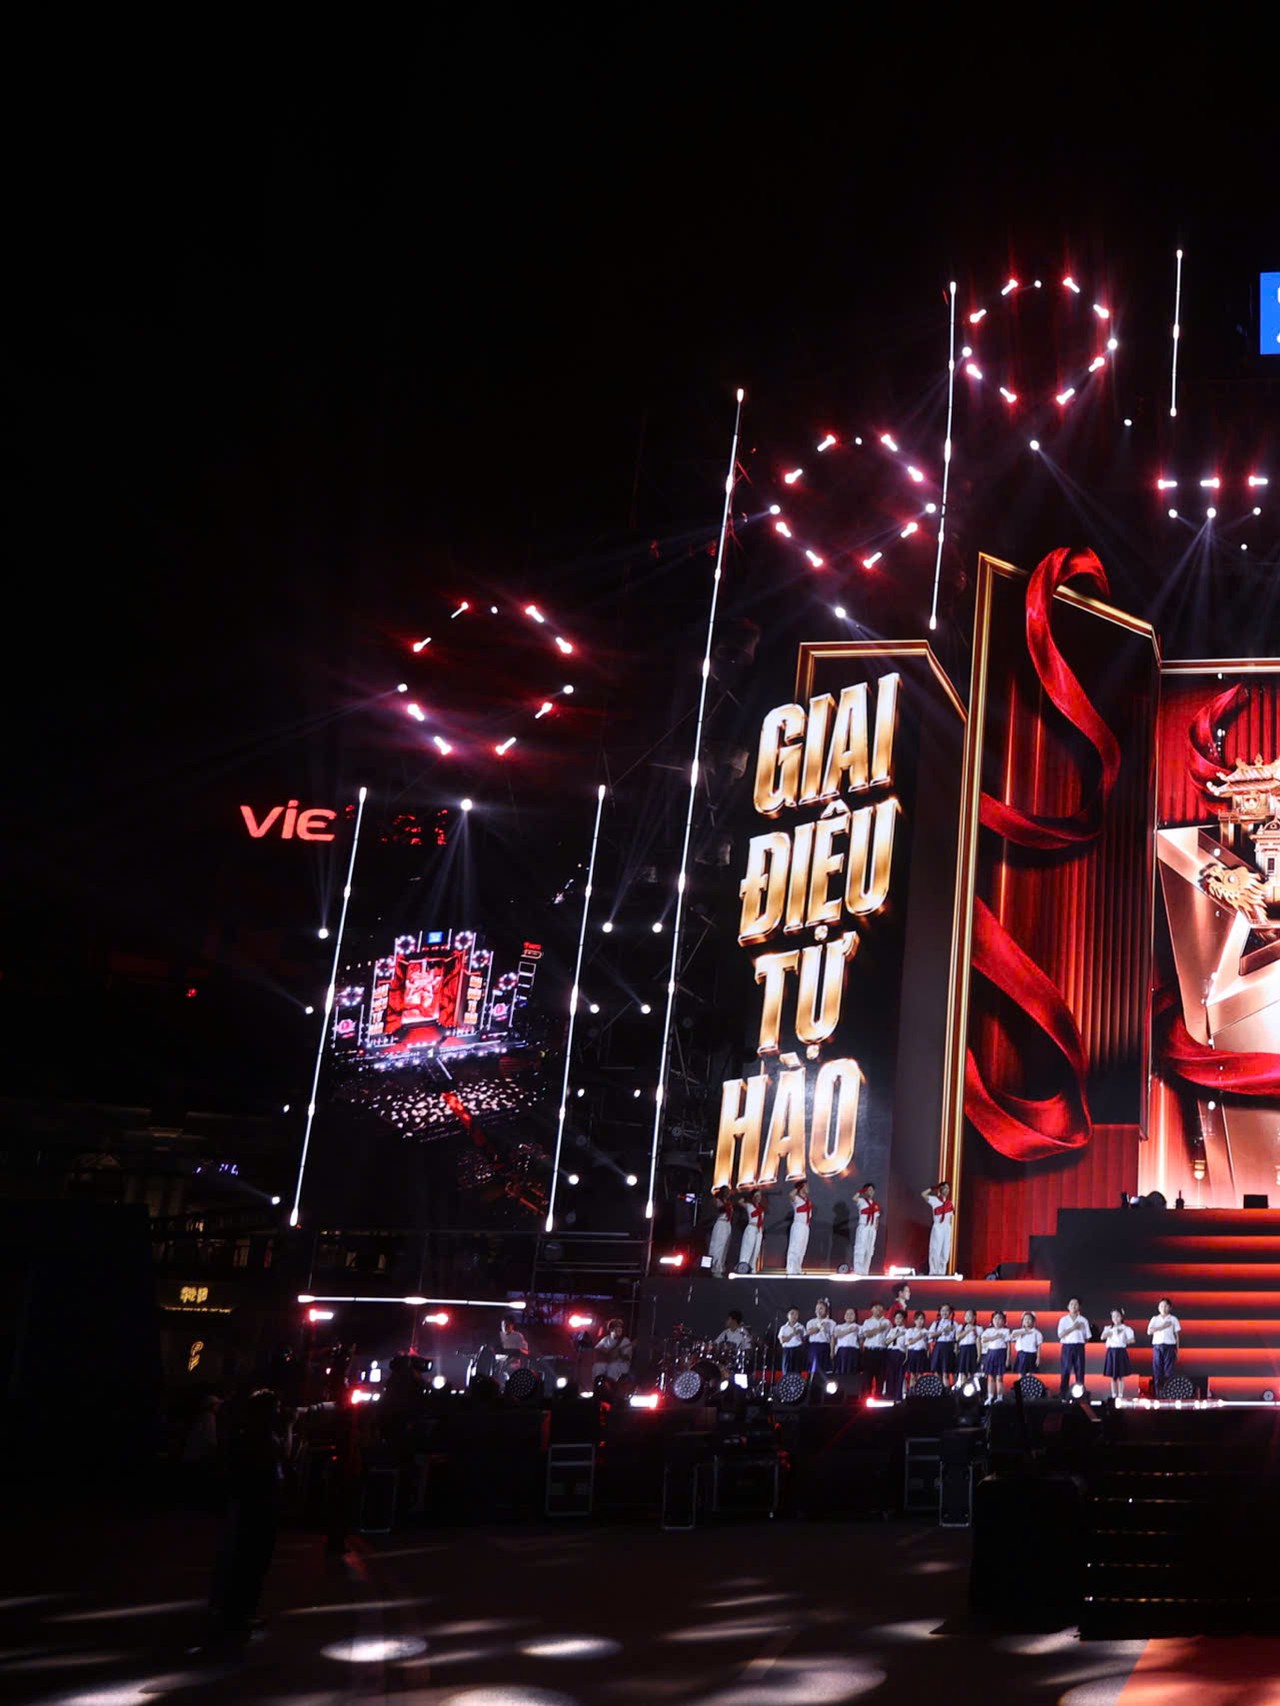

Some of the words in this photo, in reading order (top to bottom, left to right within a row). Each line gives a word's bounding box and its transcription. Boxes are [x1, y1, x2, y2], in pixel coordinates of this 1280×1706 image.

[753, 672, 901, 815] GIAI
[737, 798, 899, 946] ĐIỆU
[754, 930, 858, 1060] TỰ
[711, 1052, 862, 1194] HÀO
